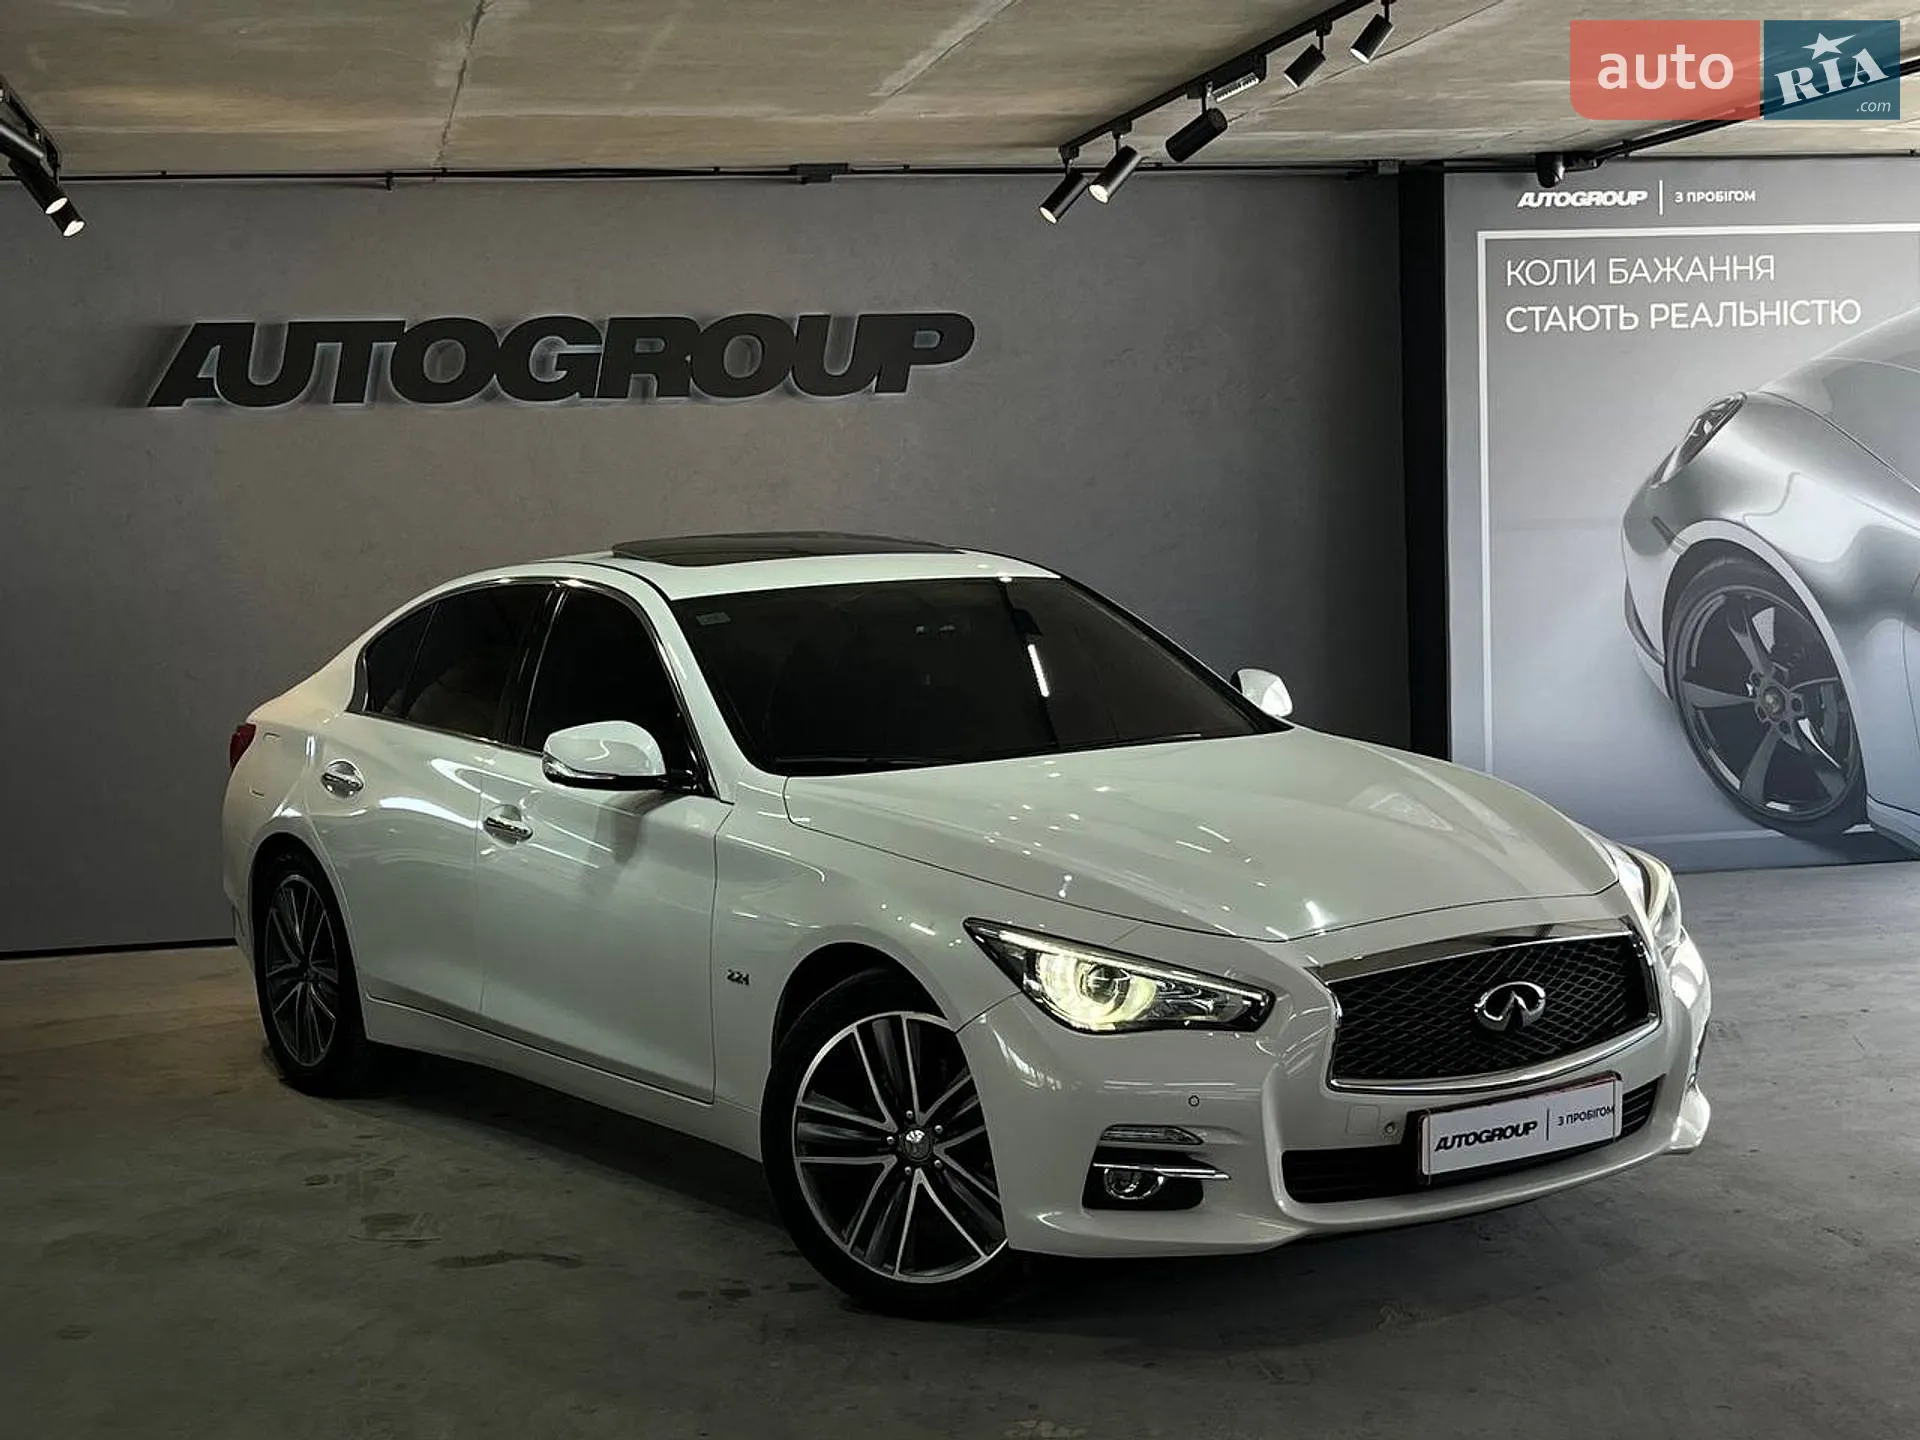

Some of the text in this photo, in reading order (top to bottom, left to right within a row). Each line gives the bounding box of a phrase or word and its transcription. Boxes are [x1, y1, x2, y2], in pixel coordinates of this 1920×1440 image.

[1516, 190, 1649, 208] AUTOGROUP
[1687, 190, 1756, 203] ПРОБІГОМ
[1506, 255, 1775, 287] КОЛИ БАЖАННЯ
[1505, 299, 1862, 333] СТАЮТЬ РЕАЛЬНІСТЮ
[147, 312, 977, 409] AUTOGROUP
[1566, 1105, 1615, 1125] ПРОБІГОМ
[1435, 1120, 1538, 1151] AUTOGROUP
